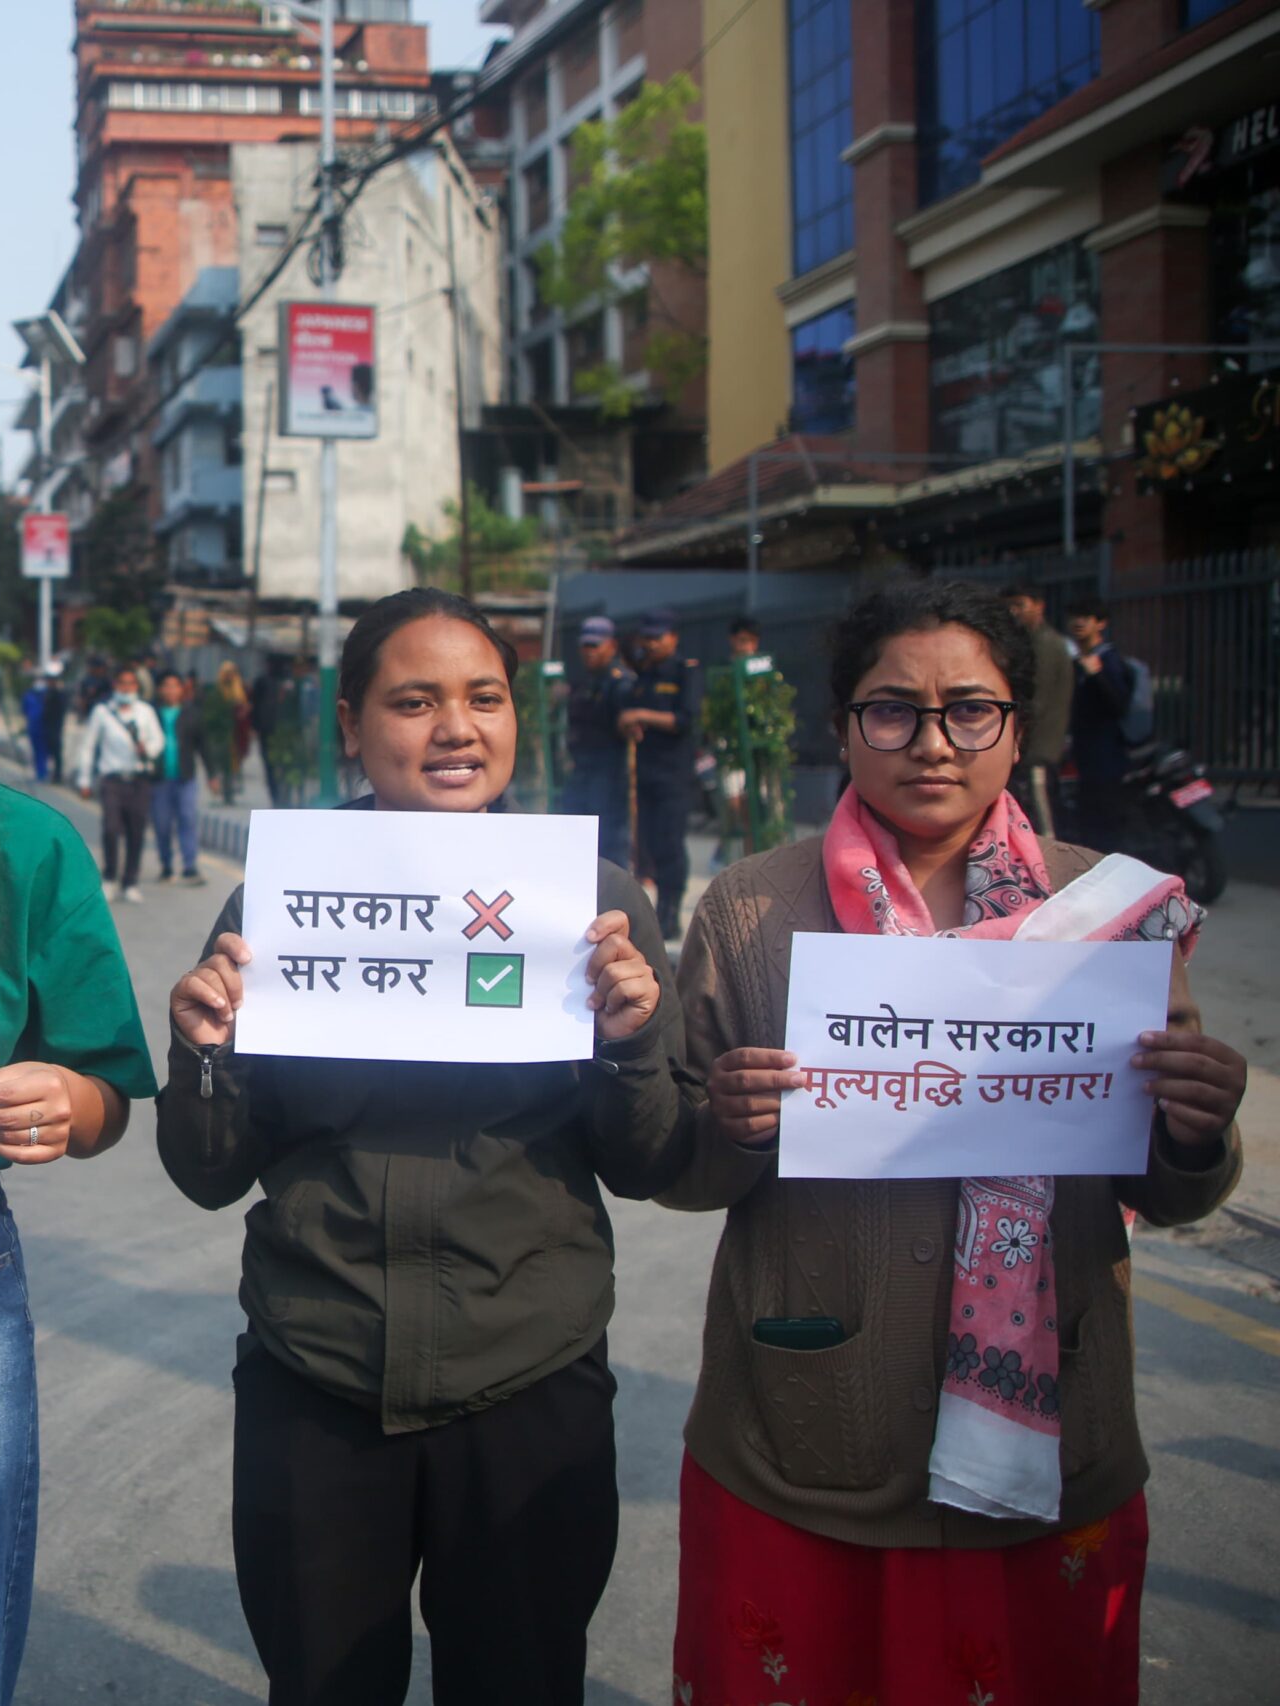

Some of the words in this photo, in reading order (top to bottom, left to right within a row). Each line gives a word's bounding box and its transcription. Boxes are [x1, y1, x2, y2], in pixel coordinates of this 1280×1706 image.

[283, 890, 440, 932] सरकार
[278, 955, 346, 992] सर
[359, 958, 433, 996] कर
[826, 1003, 934, 1050] बालेन
[945, 1019, 1095, 1053] सरकार!
[800, 1060, 966, 1111] मूल्यवृद्धि
[977, 1072, 1113, 1105] उपहार!
